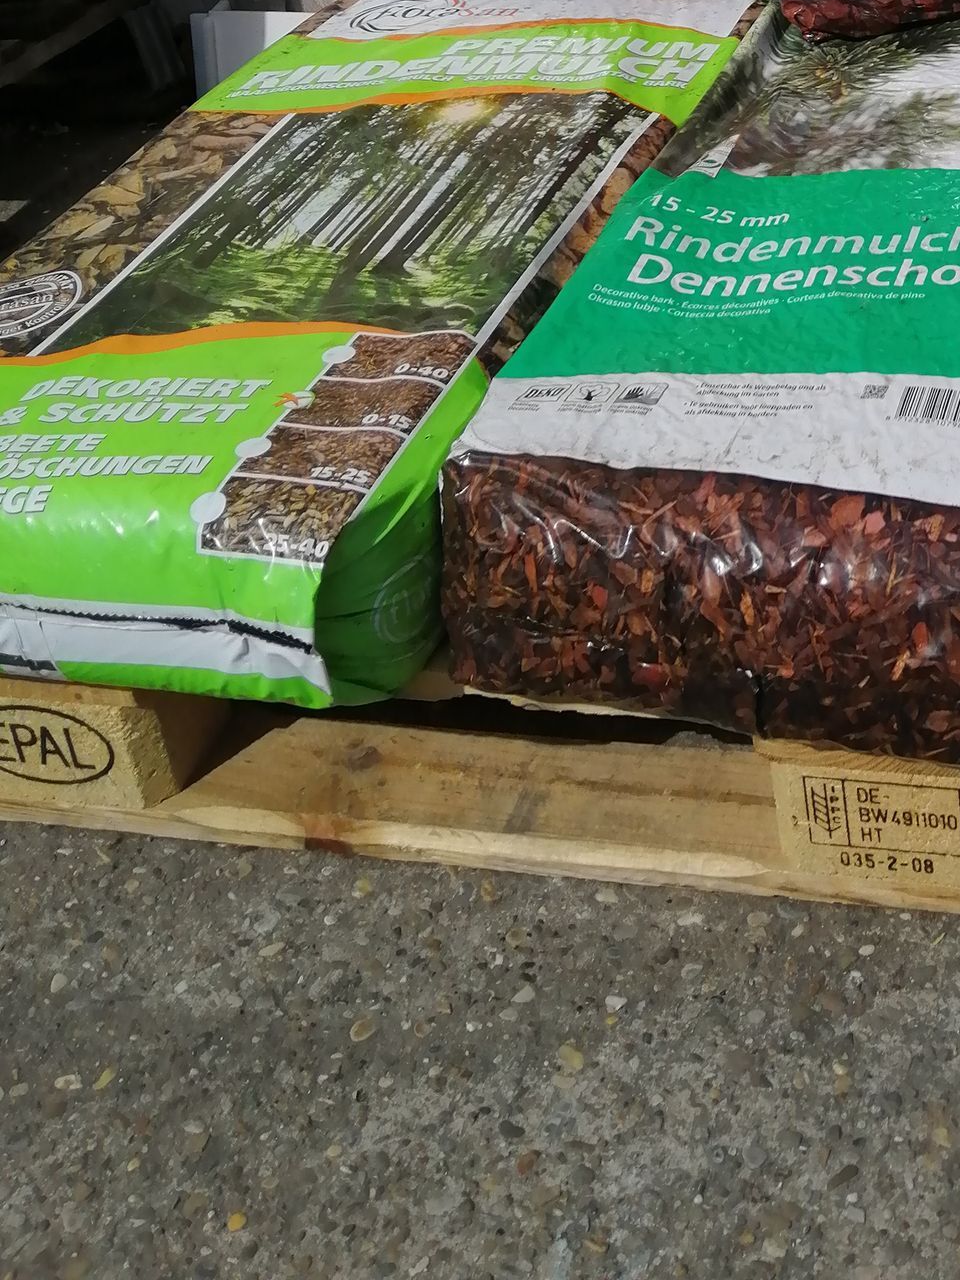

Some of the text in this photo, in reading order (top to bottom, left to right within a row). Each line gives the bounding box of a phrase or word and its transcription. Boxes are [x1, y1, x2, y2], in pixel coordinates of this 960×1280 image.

[442, 36, 720, 61] PREMIUM
[236, 55, 705, 91] RINDENMULCH
[650, 194, 790, 228] 15 25 mm
[0, 294, 54, 312] rasan
[588, 292, 771, 319] Okrasno lubje Corteccia decorativa
[592, 283, 926, 311] Decorative bark décoratives Corteza decorativa de pino
[393, 363, 450, 379] 0-40
[19, 375, 273, 402] DEKORIERT
[38, 397, 250, 423] SCHÜTZT
[361, 413, 413, 430] 0-15
[0, 454, 214, 480] ÖSCHUNGEN
[310, 467, 371, 484] 15-25
[263, 533, 330, 558] 25-40
[861, 827, 883, 843] HT
[840, 852, 935, 874] 035-2-08
